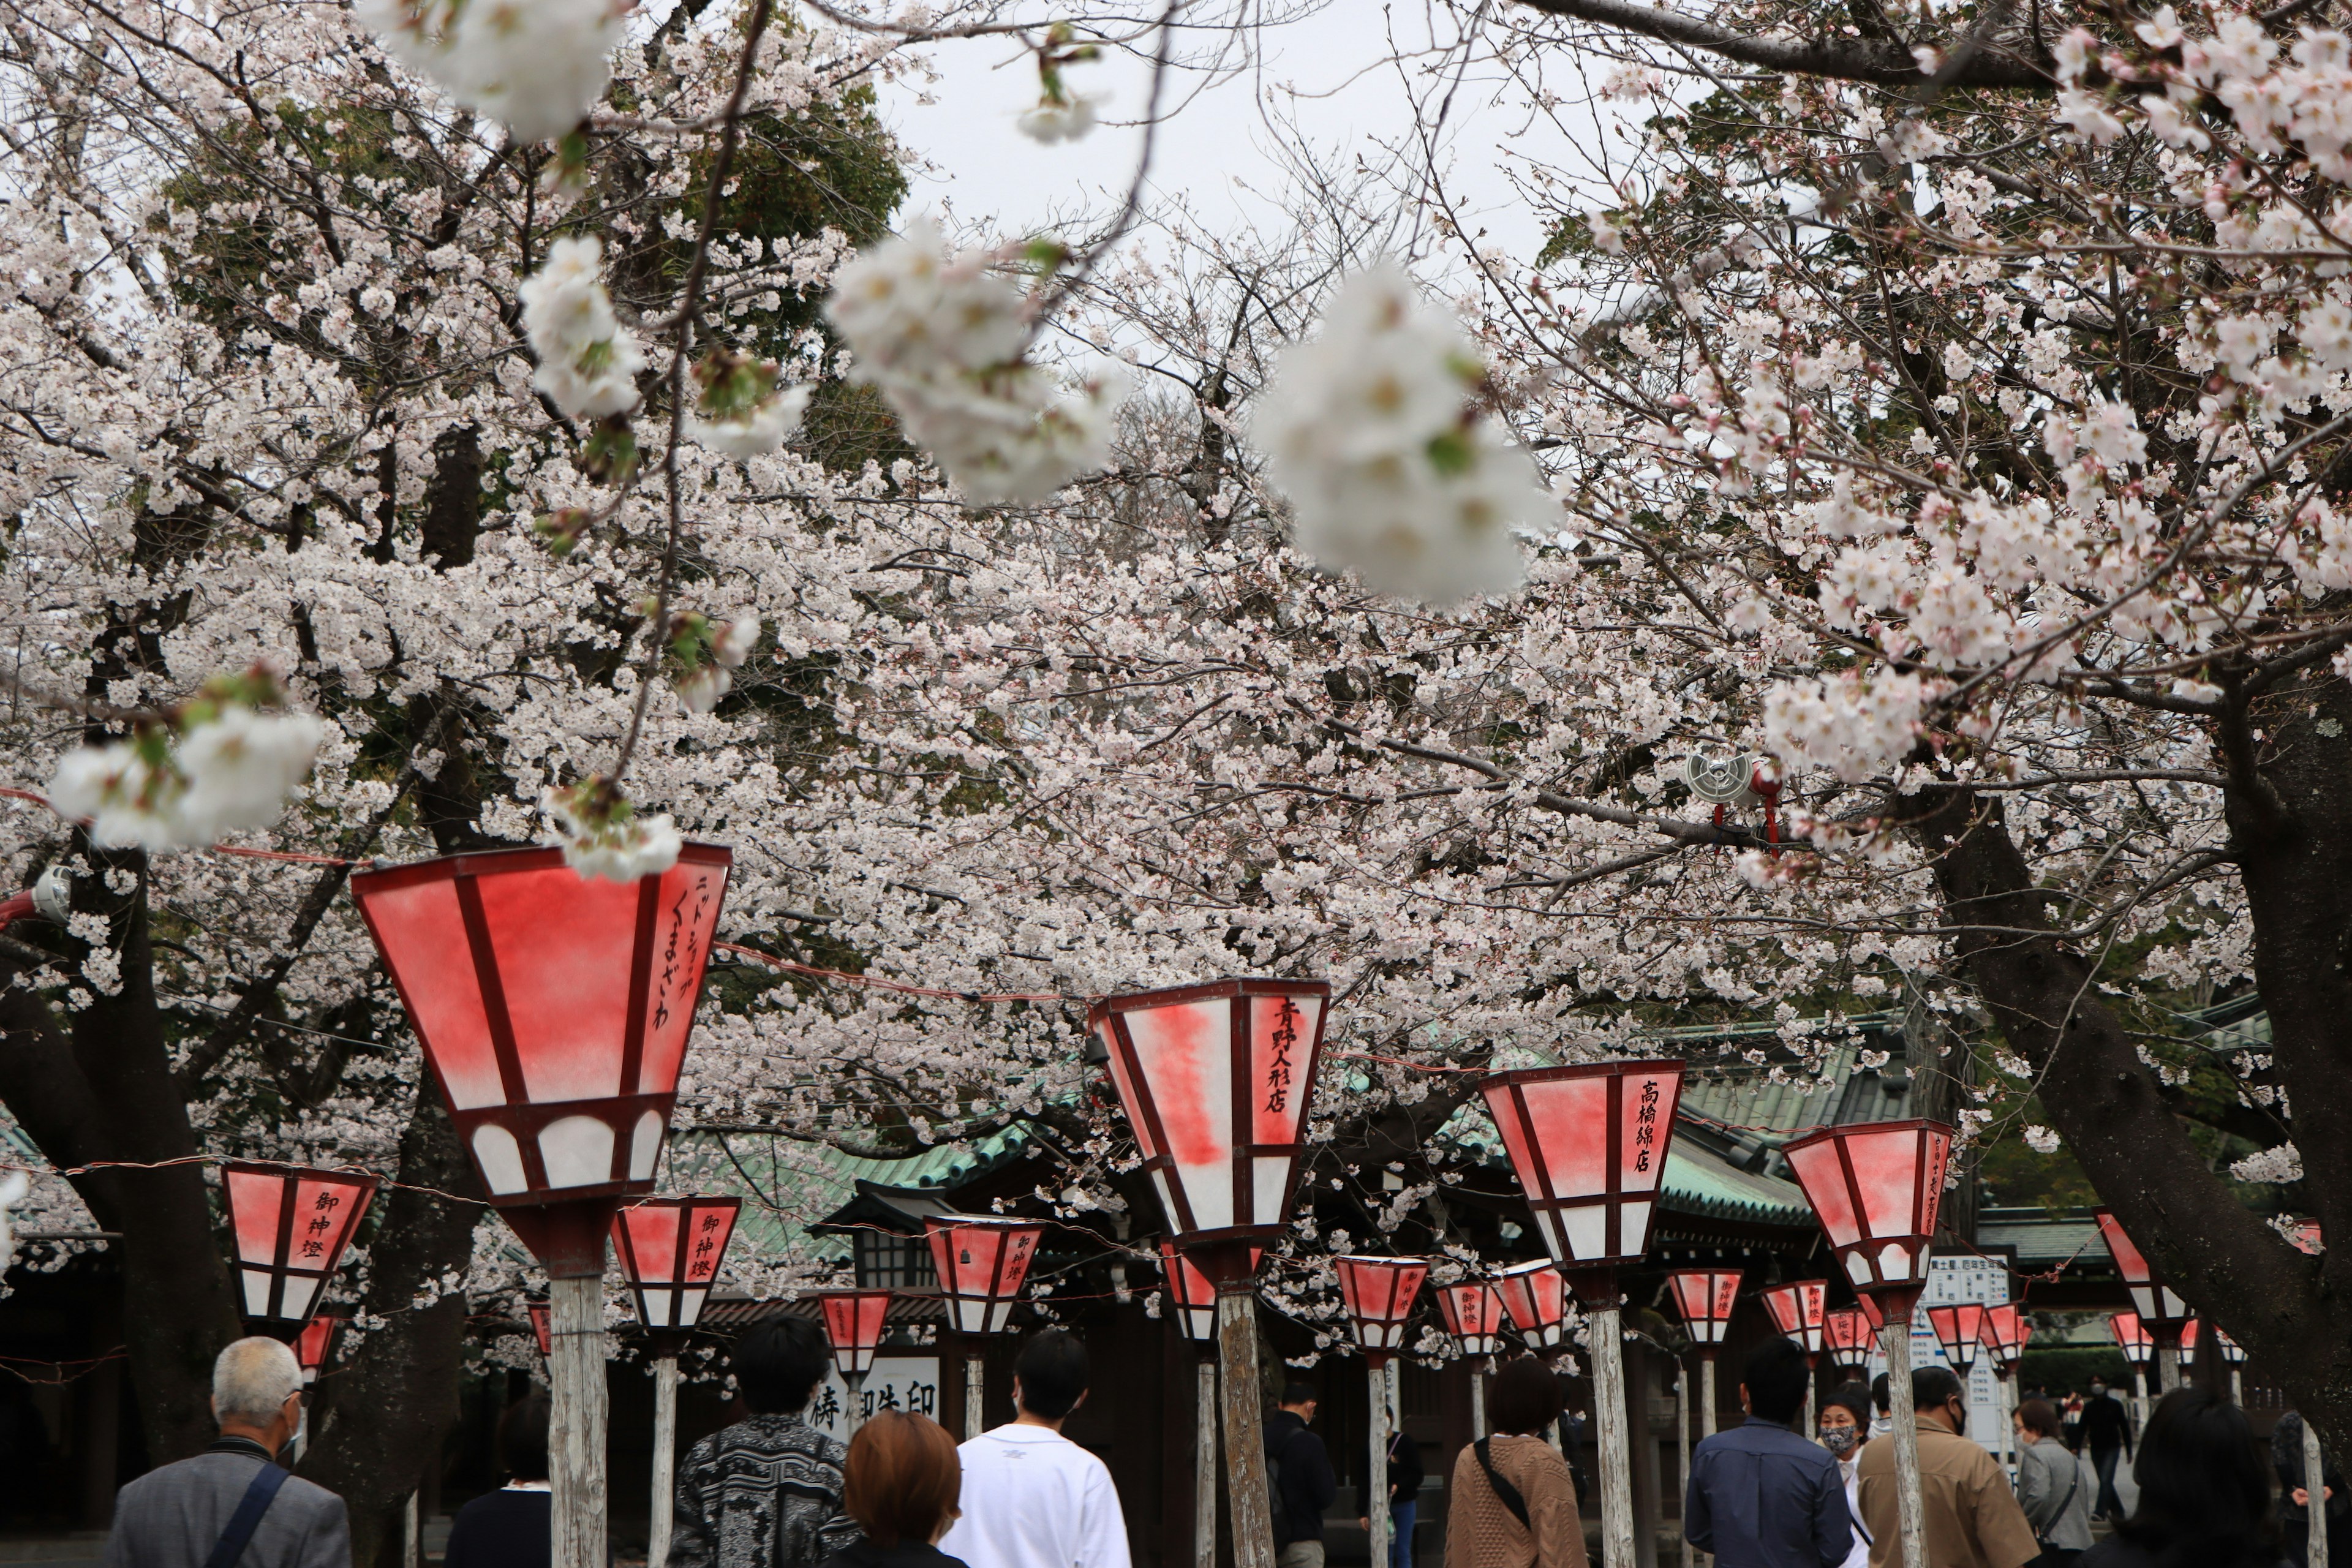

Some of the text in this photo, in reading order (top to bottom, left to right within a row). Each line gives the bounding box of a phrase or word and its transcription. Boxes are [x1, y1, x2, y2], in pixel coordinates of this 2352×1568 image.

[652, 890, 687, 1031] くまざわ
[1264, 997, 1300, 1113] 青野人形店
[1634, 1080, 1659, 1172] 高橋綿店
[296, 1192, 339, 1257] 御神燈
[690, 1215, 719, 1276] 御神燈
[1006, 1235, 1030, 1280] 御神燈
[1462, 1292, 1477, 1324] 御神燈
[1719, 1281, 1732, 1312] 御神燈
[1809, 1287, 1820, 1318] 御神燈
